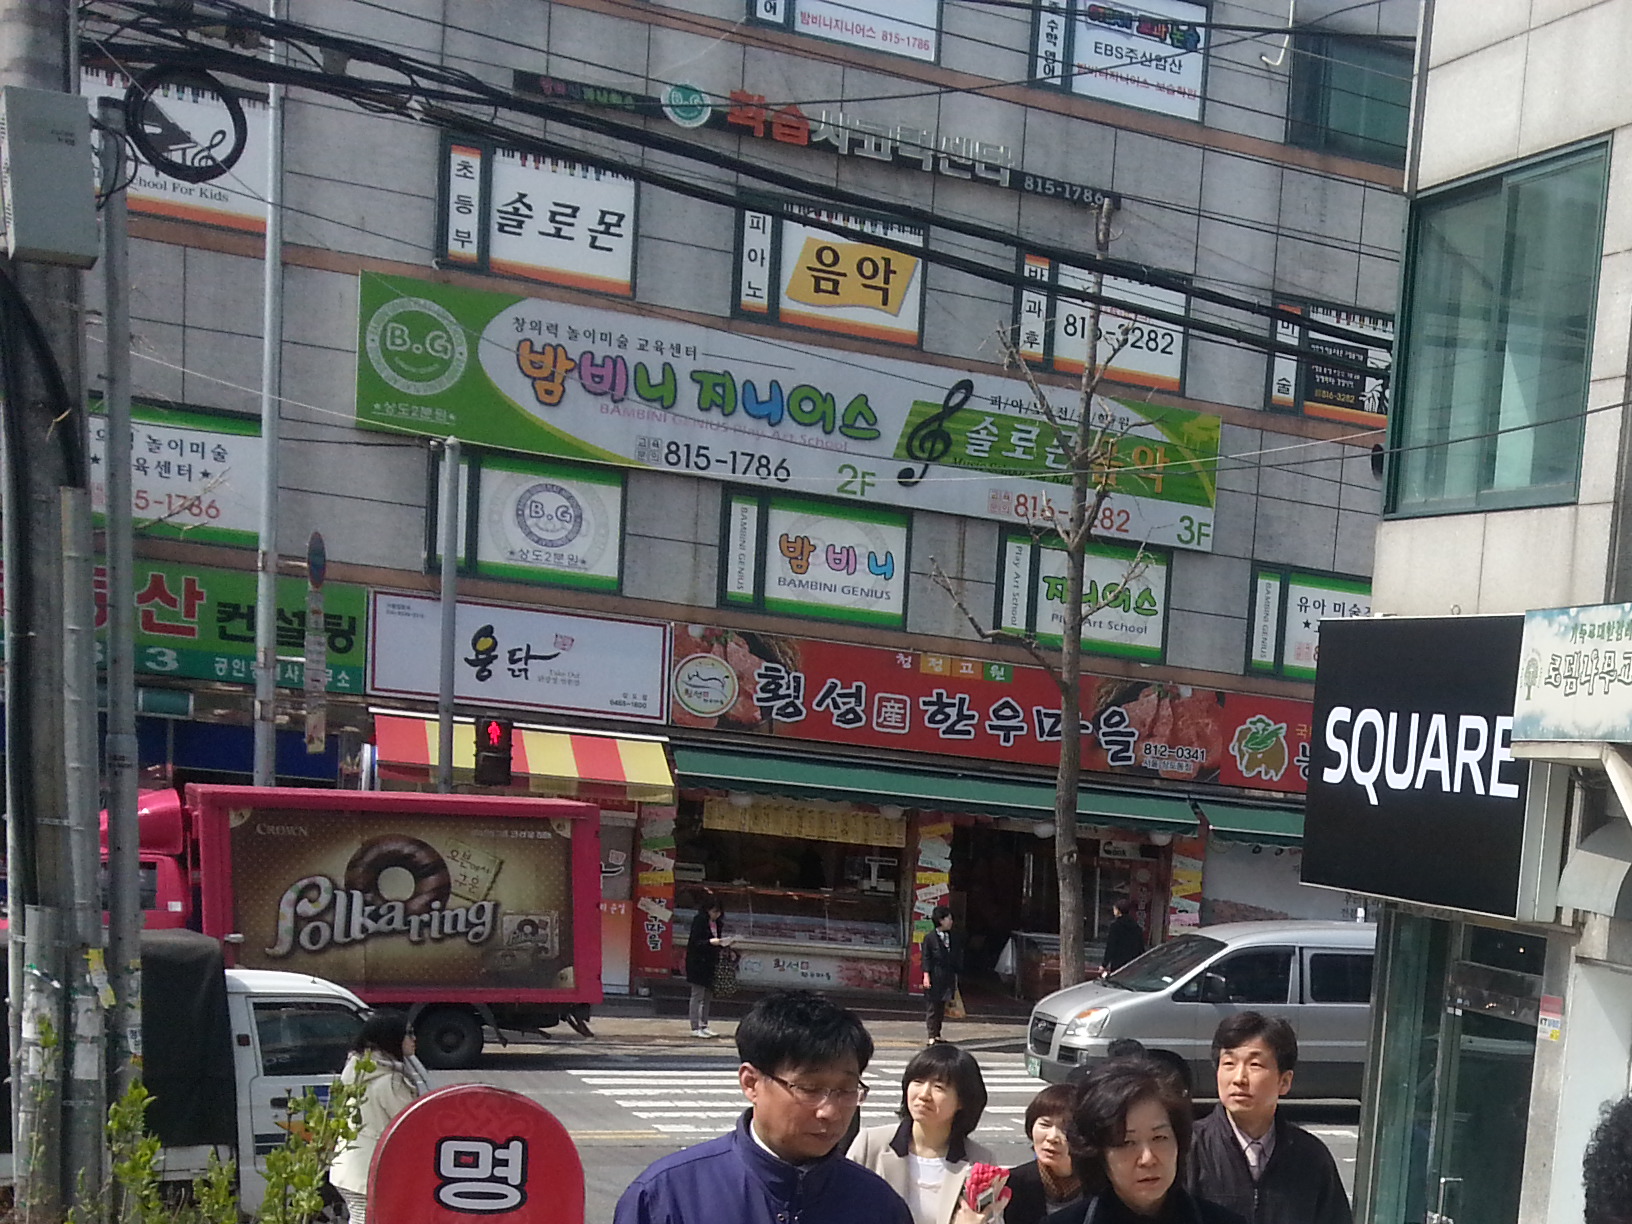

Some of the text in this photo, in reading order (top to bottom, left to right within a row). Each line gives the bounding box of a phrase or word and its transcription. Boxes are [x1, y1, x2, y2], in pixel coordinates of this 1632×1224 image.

[800, 10, 930, 51] 밤비니지니어스 815-1786
[171, 181, 196, 198] For
[199, 186, 230, 203] Kids
[452, 159, 475, 250] 초등부
[495, 191, 627, 253] 솔로몬
[745, 212, 768, 301] 피아노
[805, 245, 898, 307] 음악
[512, 316, 698, 361] 창의력 놀이미술 교육센터
[146, 434, 229, 463] 놀이미술
[664, 441, 877, 498] 815-1786 2F
[529, 500, 574, 525] B.G
[1176, 514, 1212, 546] 3F
[778, 532, 896, 581] 밤비니
[777, 576, 892, 602] BAMBINI GENIUS
[1297, 596, 1328, 618] 유아
[1084, 615, 1104, 630] Art
[1107, 619, 1148, 635] School
[753, 662, 867, 729] 횡성
[1144, 742, 1207, 763] 812-0341
[1322, 705, 1521, 806] SQUARE
[256, 823, 309, 837] CROWN
[265, 874, 498, 957] Polkaring
